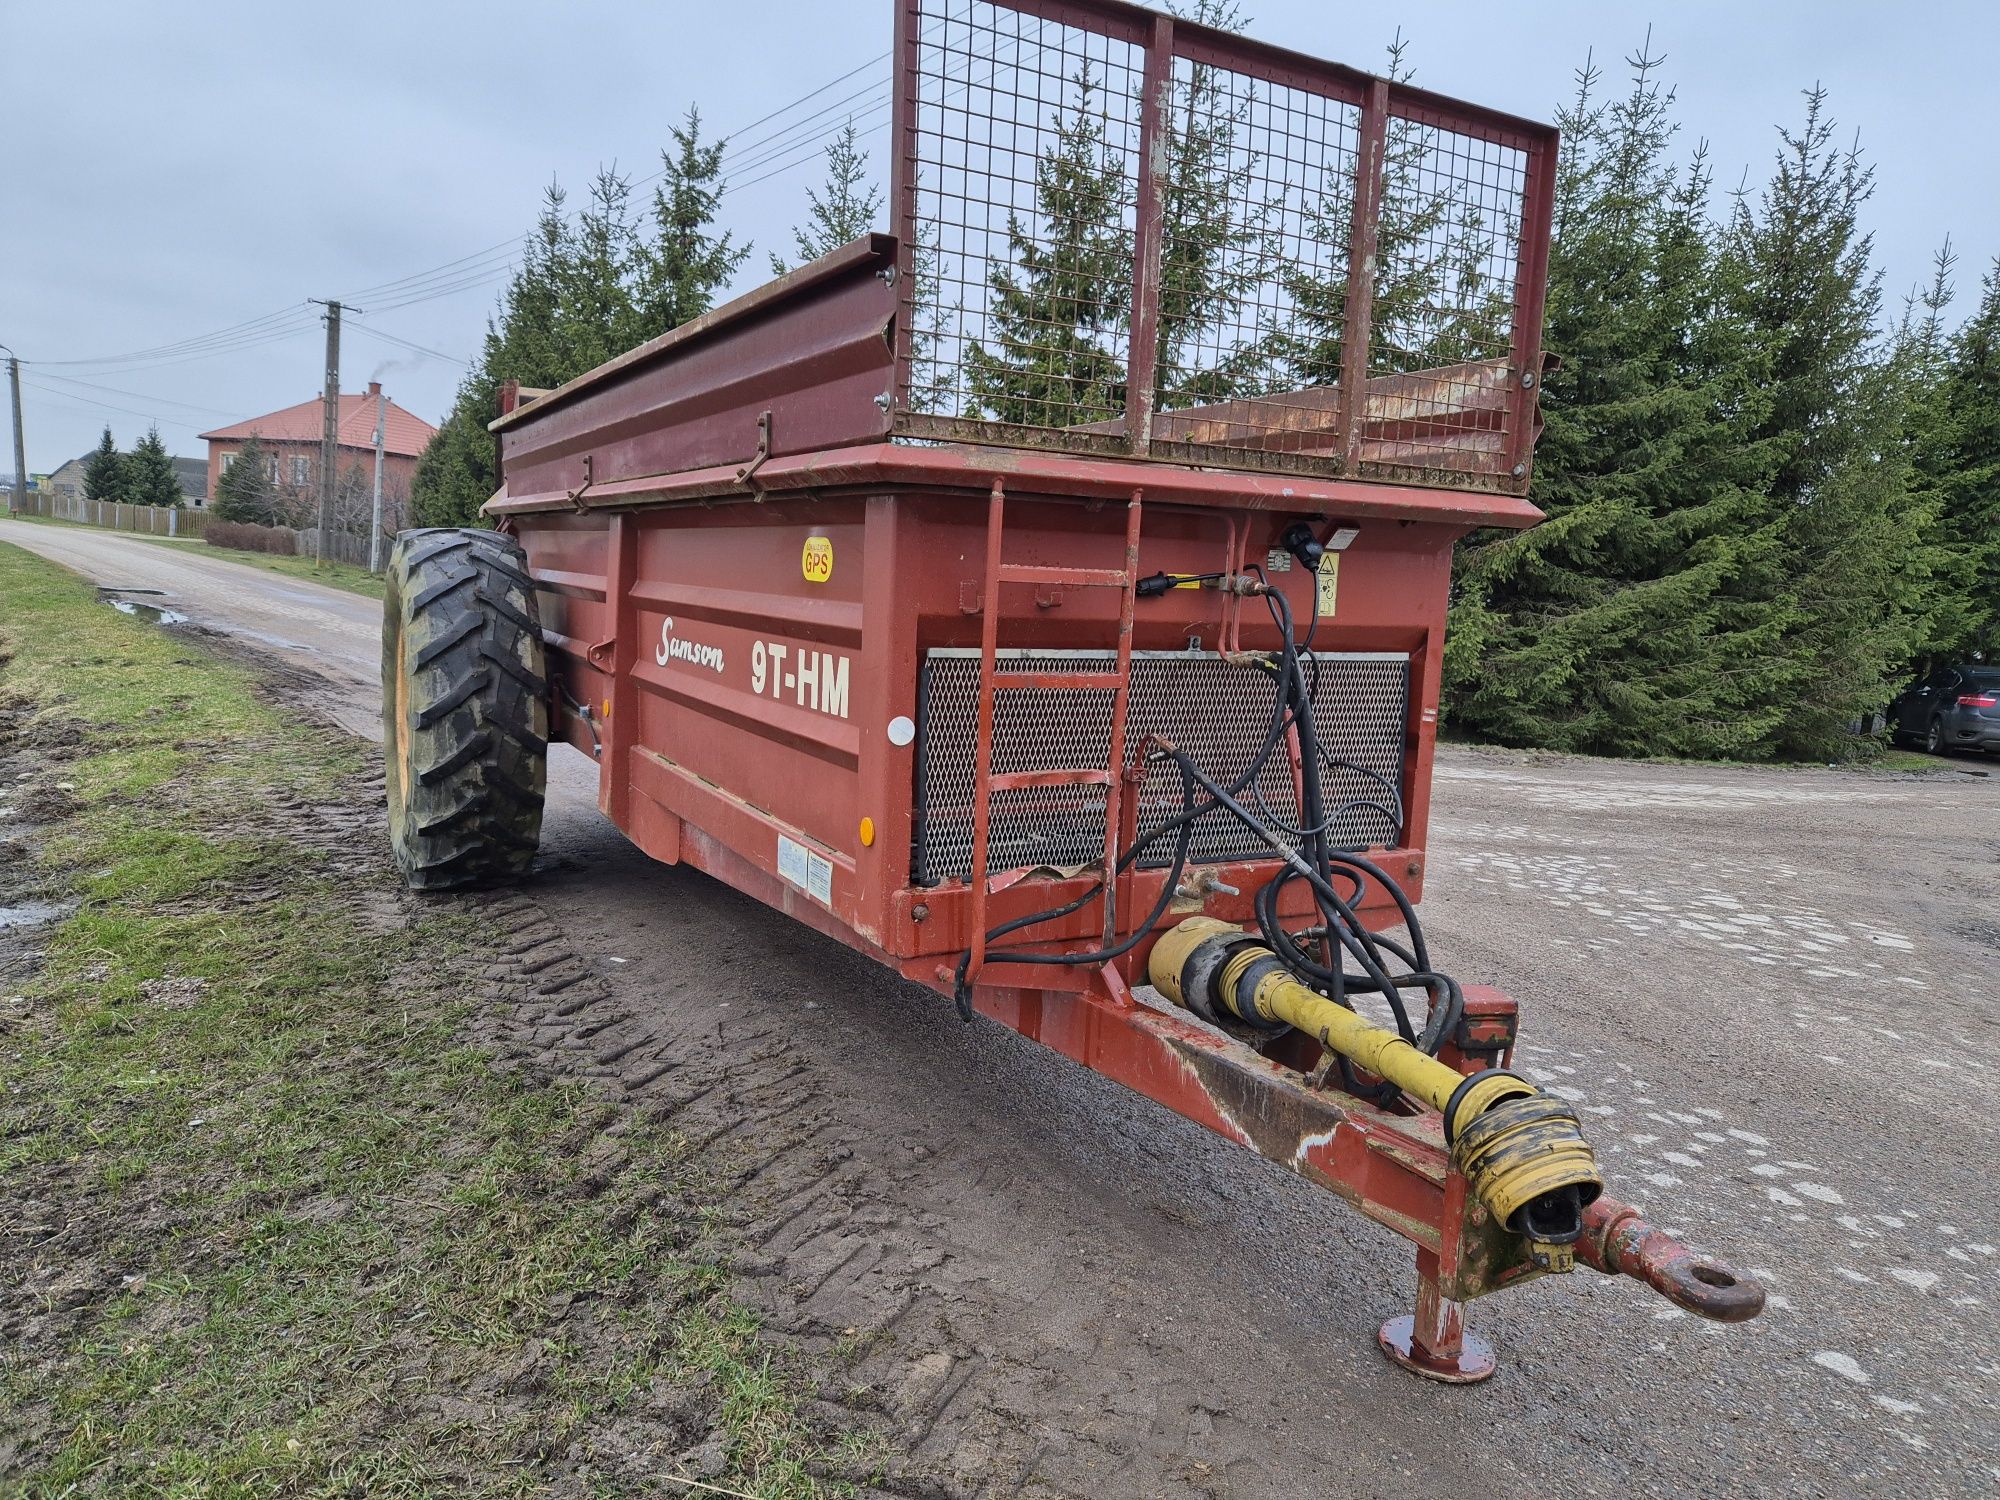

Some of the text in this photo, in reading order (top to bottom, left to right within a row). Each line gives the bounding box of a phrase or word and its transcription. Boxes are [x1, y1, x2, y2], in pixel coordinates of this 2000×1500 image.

[805, 552, 828, 575] GPS
[655, 616, 725, 673] Samson
[751, 640, 850, 719] 9T-HM
